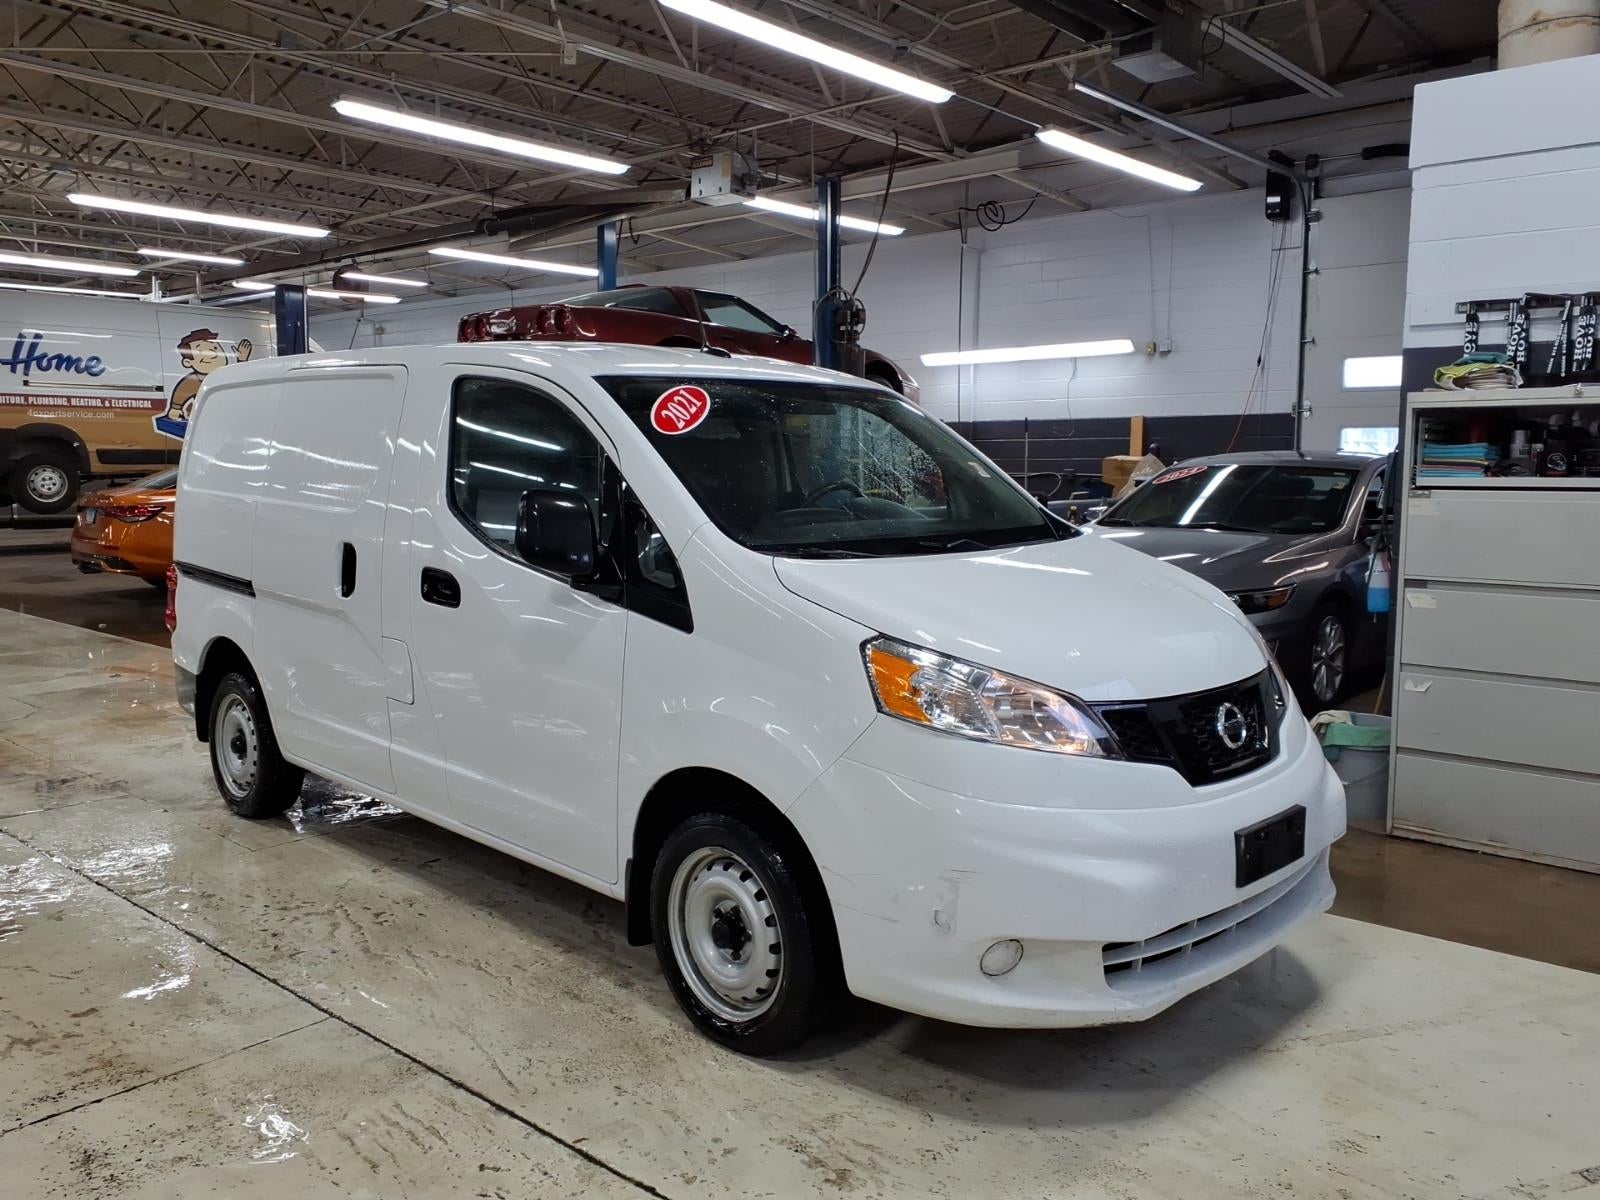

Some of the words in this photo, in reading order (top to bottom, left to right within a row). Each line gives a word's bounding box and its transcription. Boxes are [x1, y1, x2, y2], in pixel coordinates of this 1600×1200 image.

[0, 332, 106, 377] Home
[1506, 313, 1525, 357] HOVE
[1573, 315, 1586, 360] HOVE
[111, 400, 152, 408] ELECTRICAL
[660, 389, 702, 430] 2021
